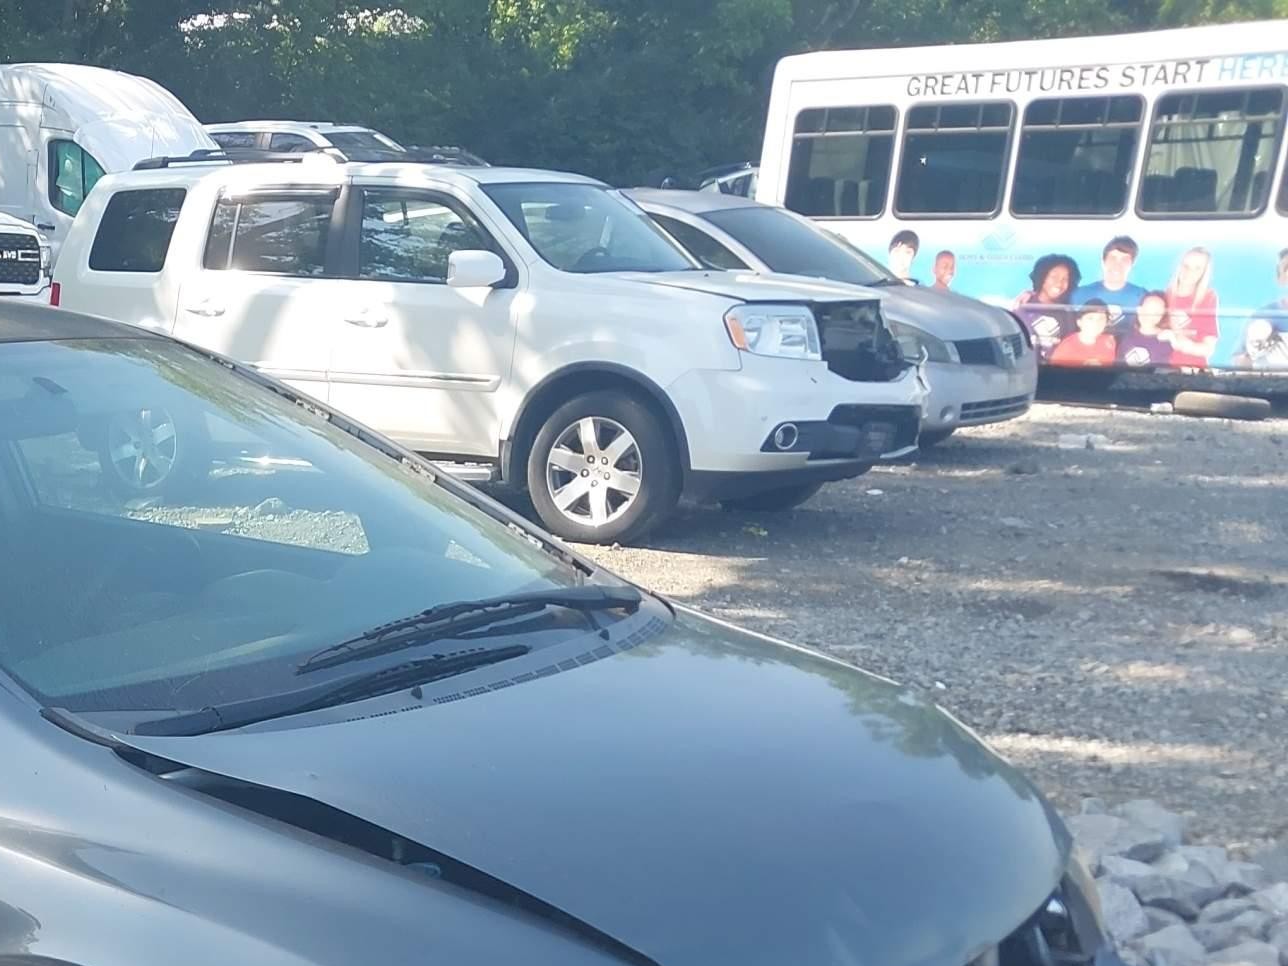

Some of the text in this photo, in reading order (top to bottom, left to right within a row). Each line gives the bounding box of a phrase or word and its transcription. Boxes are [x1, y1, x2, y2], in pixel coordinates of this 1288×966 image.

[906, 74, 985, 97] GREAT
[989, 66, 1110, 94] FUTURES
[1119, 59, 1210, 88] START
